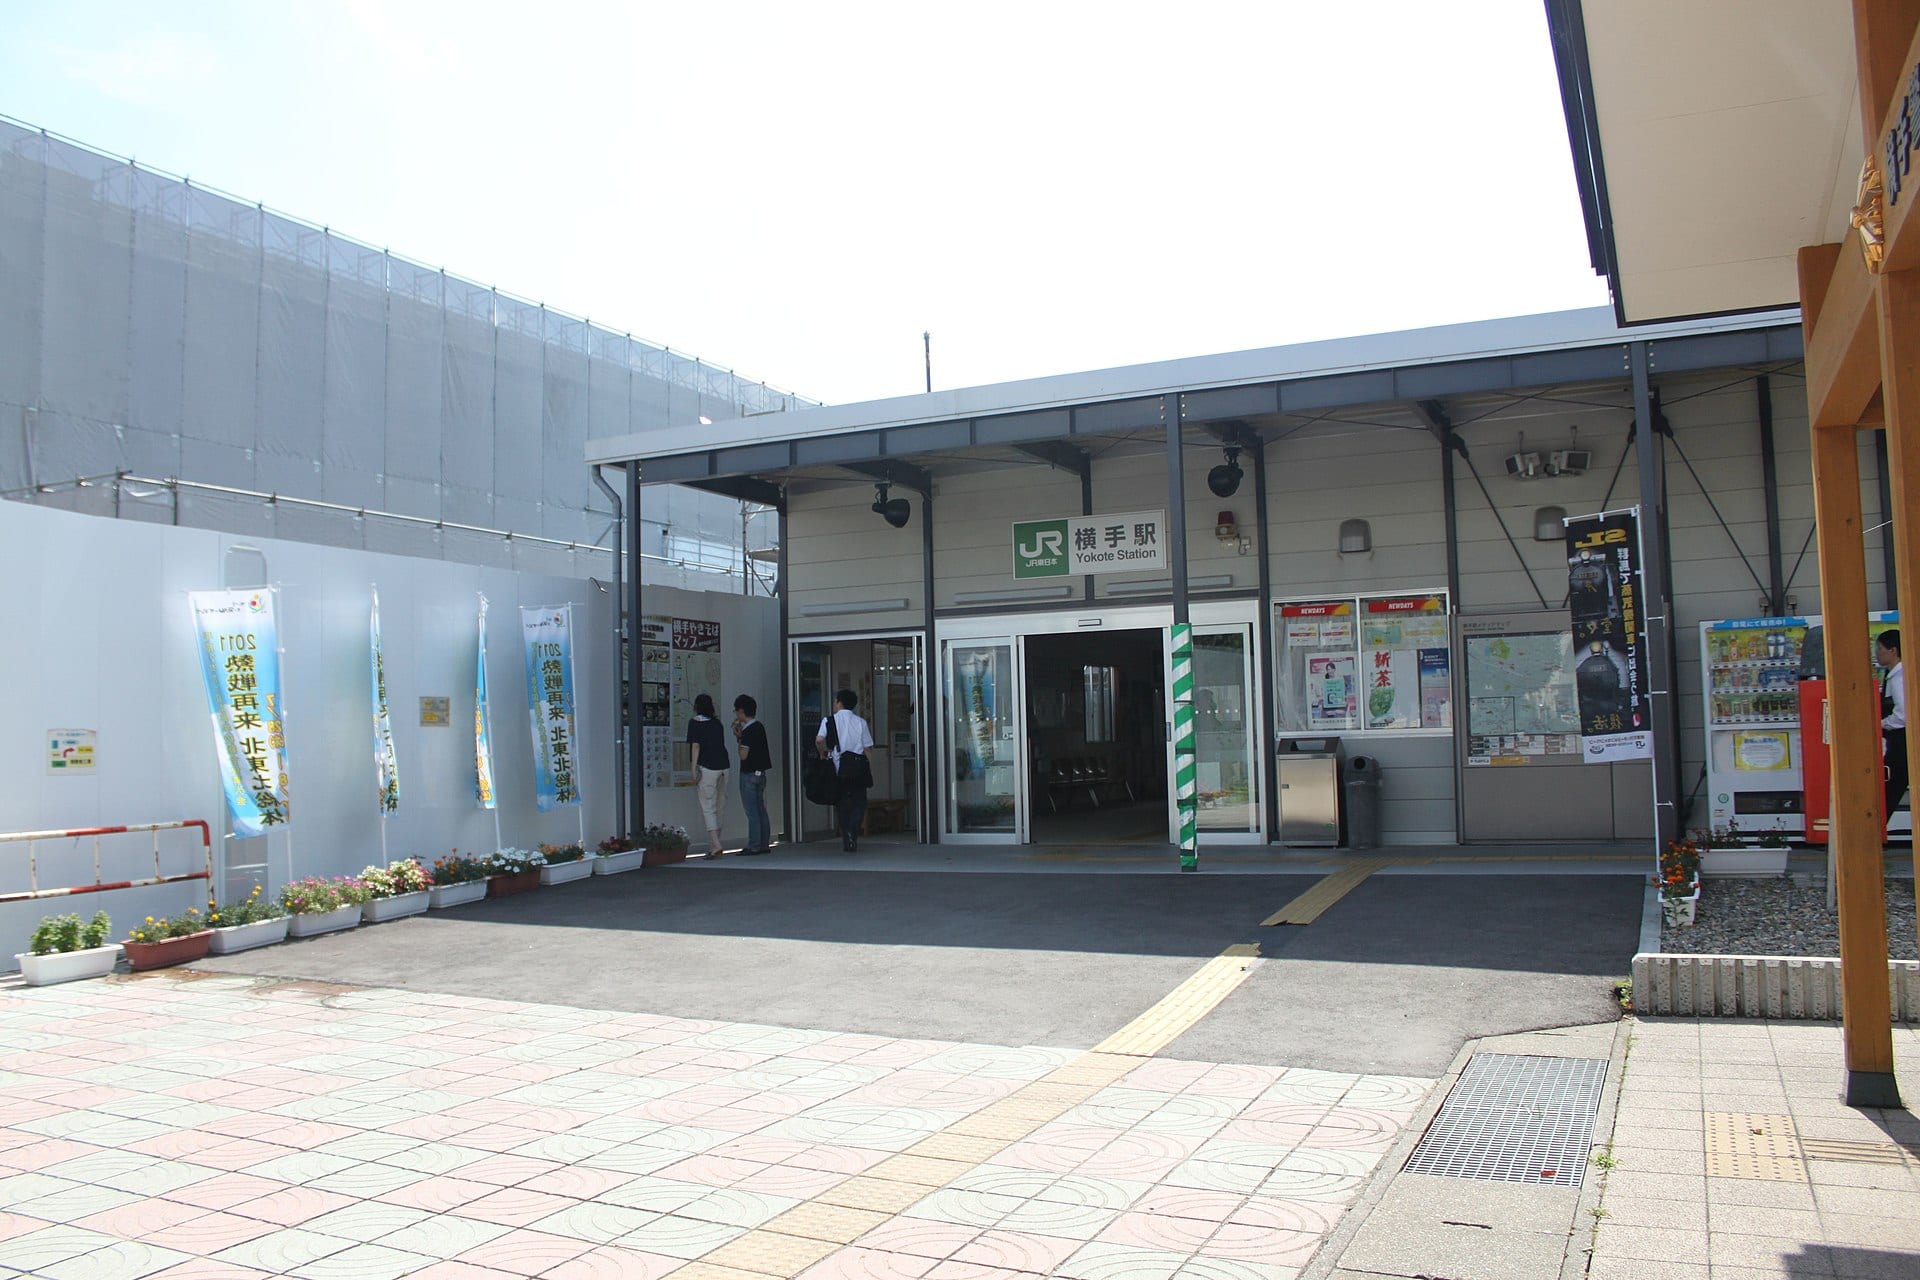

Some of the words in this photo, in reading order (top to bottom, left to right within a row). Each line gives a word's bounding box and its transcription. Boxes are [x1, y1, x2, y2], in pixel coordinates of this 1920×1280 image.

[1019, 530, 1064, 559] JR
[1075, 522, 1156, 550] 横手駅
[1025, 557, 1059, 568] JR東日本
[1076, 550, 1115, 564] Yokote
[1117, 547, 1157, 561] Station
[672, 619, 720, 637] 横手やきそば
[1374, 650, 1393, 688] 新茶
